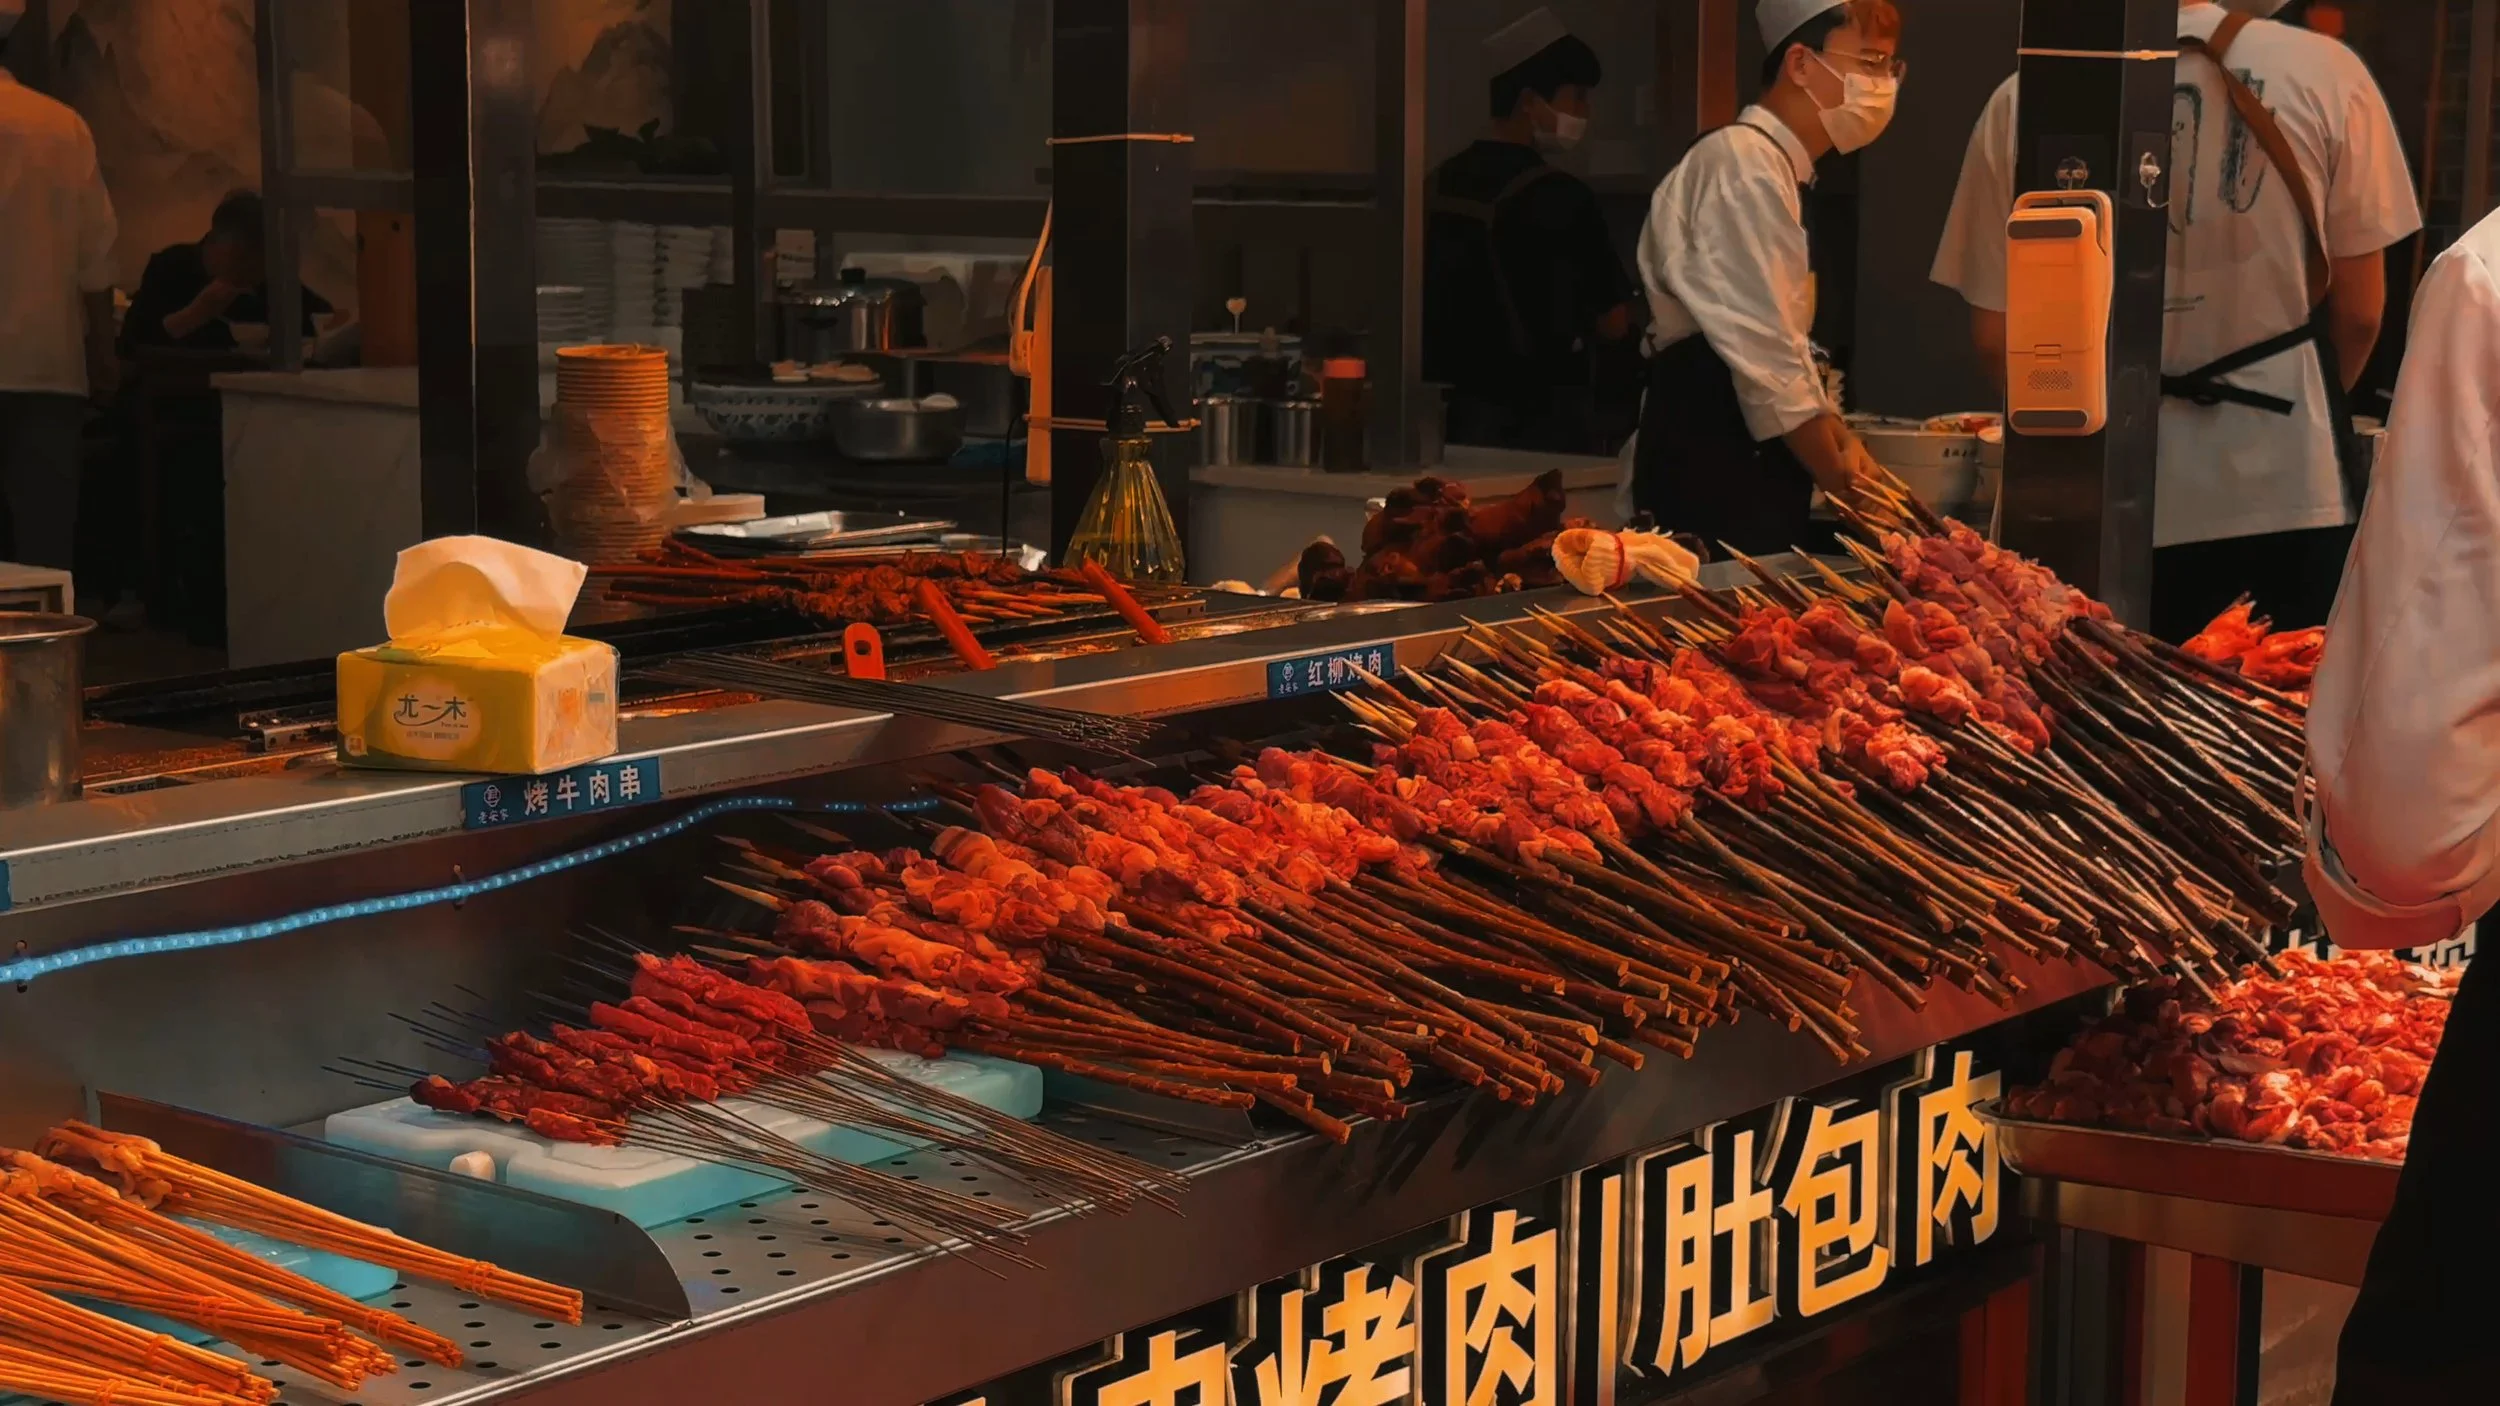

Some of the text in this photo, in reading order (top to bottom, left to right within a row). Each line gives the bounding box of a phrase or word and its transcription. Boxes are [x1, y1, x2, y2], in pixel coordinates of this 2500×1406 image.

[1308, 649, 1381, 687] 红柳烤肉
[524, 765, 640, 816] 烤牛肉串
